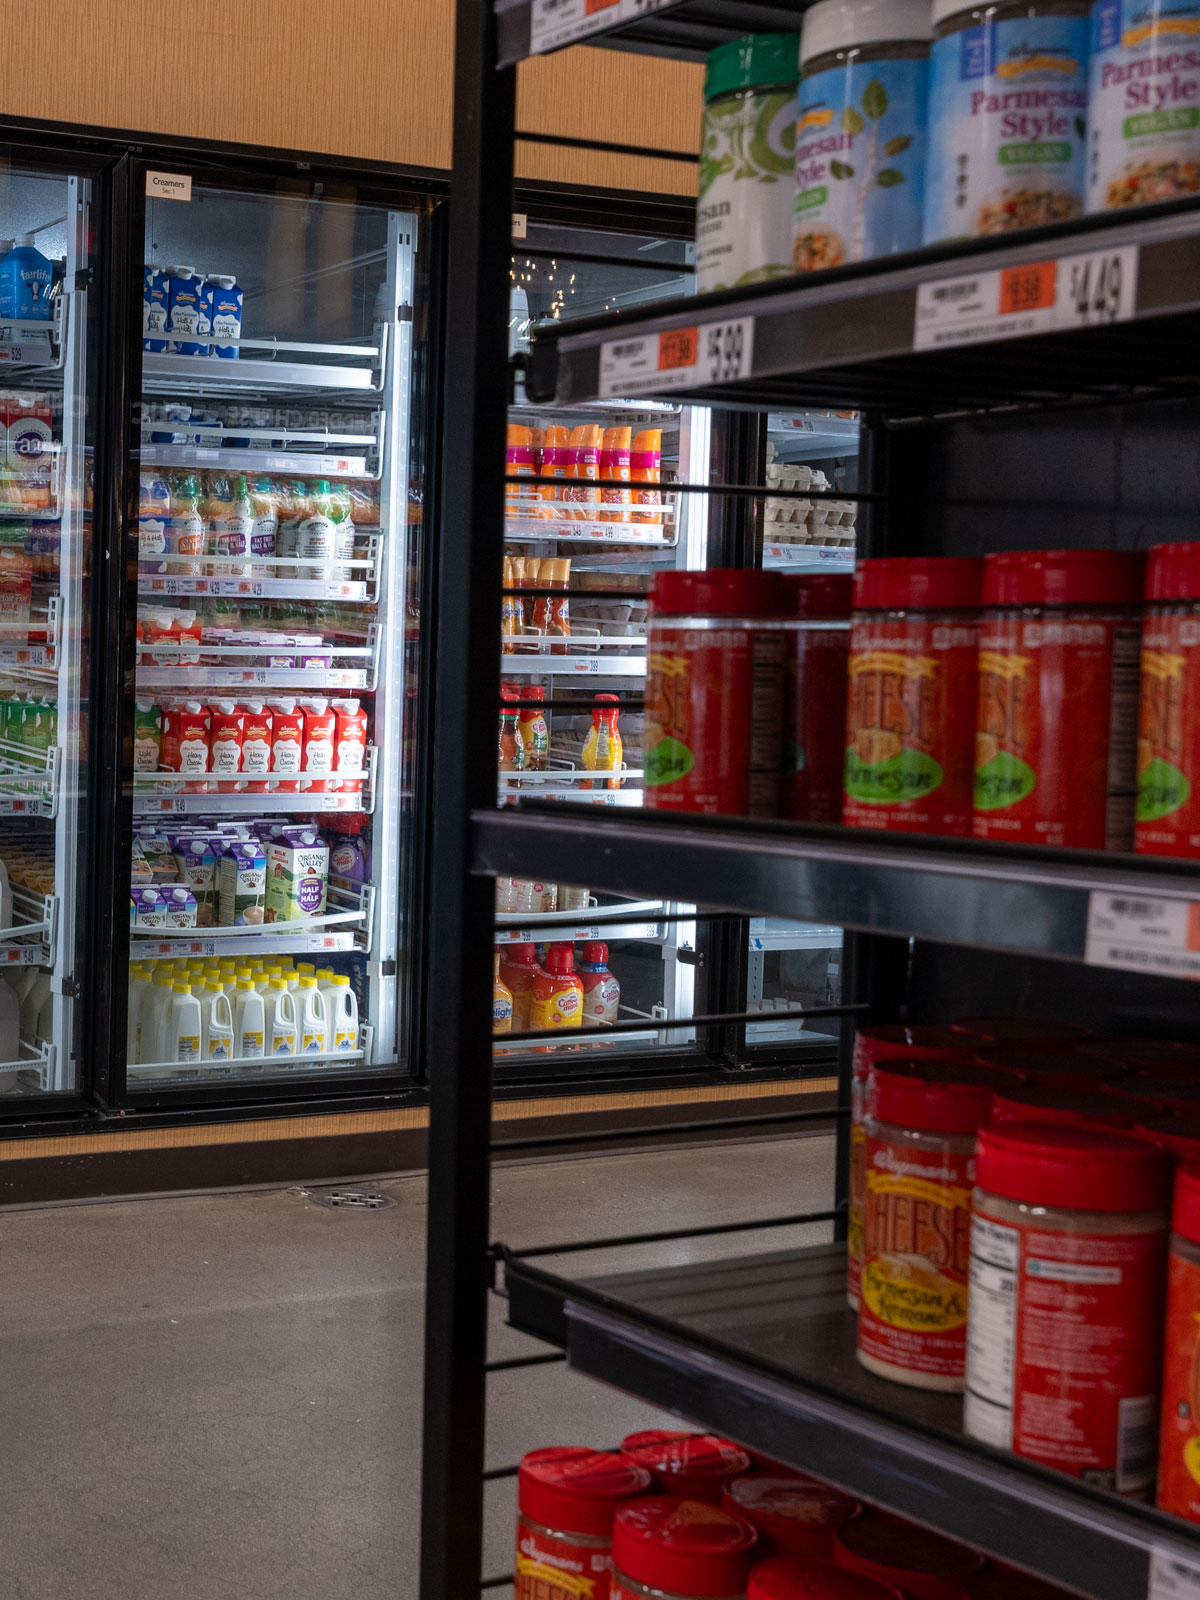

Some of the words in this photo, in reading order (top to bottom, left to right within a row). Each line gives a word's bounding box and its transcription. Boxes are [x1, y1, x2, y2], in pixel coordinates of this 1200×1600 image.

[1124, 74, 1199, 110] Style
[1001, 110, 1069, 141] Style
[153, 178, 185, 188] Creamers
[21, 269, 51, 281] fairlife
[280, 751, 294, 759] Heavy
[300, 860, 323, 868] VALLEY
[602, 988, 619, 999] Coffee
[558, 998, 579, 1007] Coffee
[563, 1003, 579, 1011] mate
[493, 1007, 512, 1018] elight
